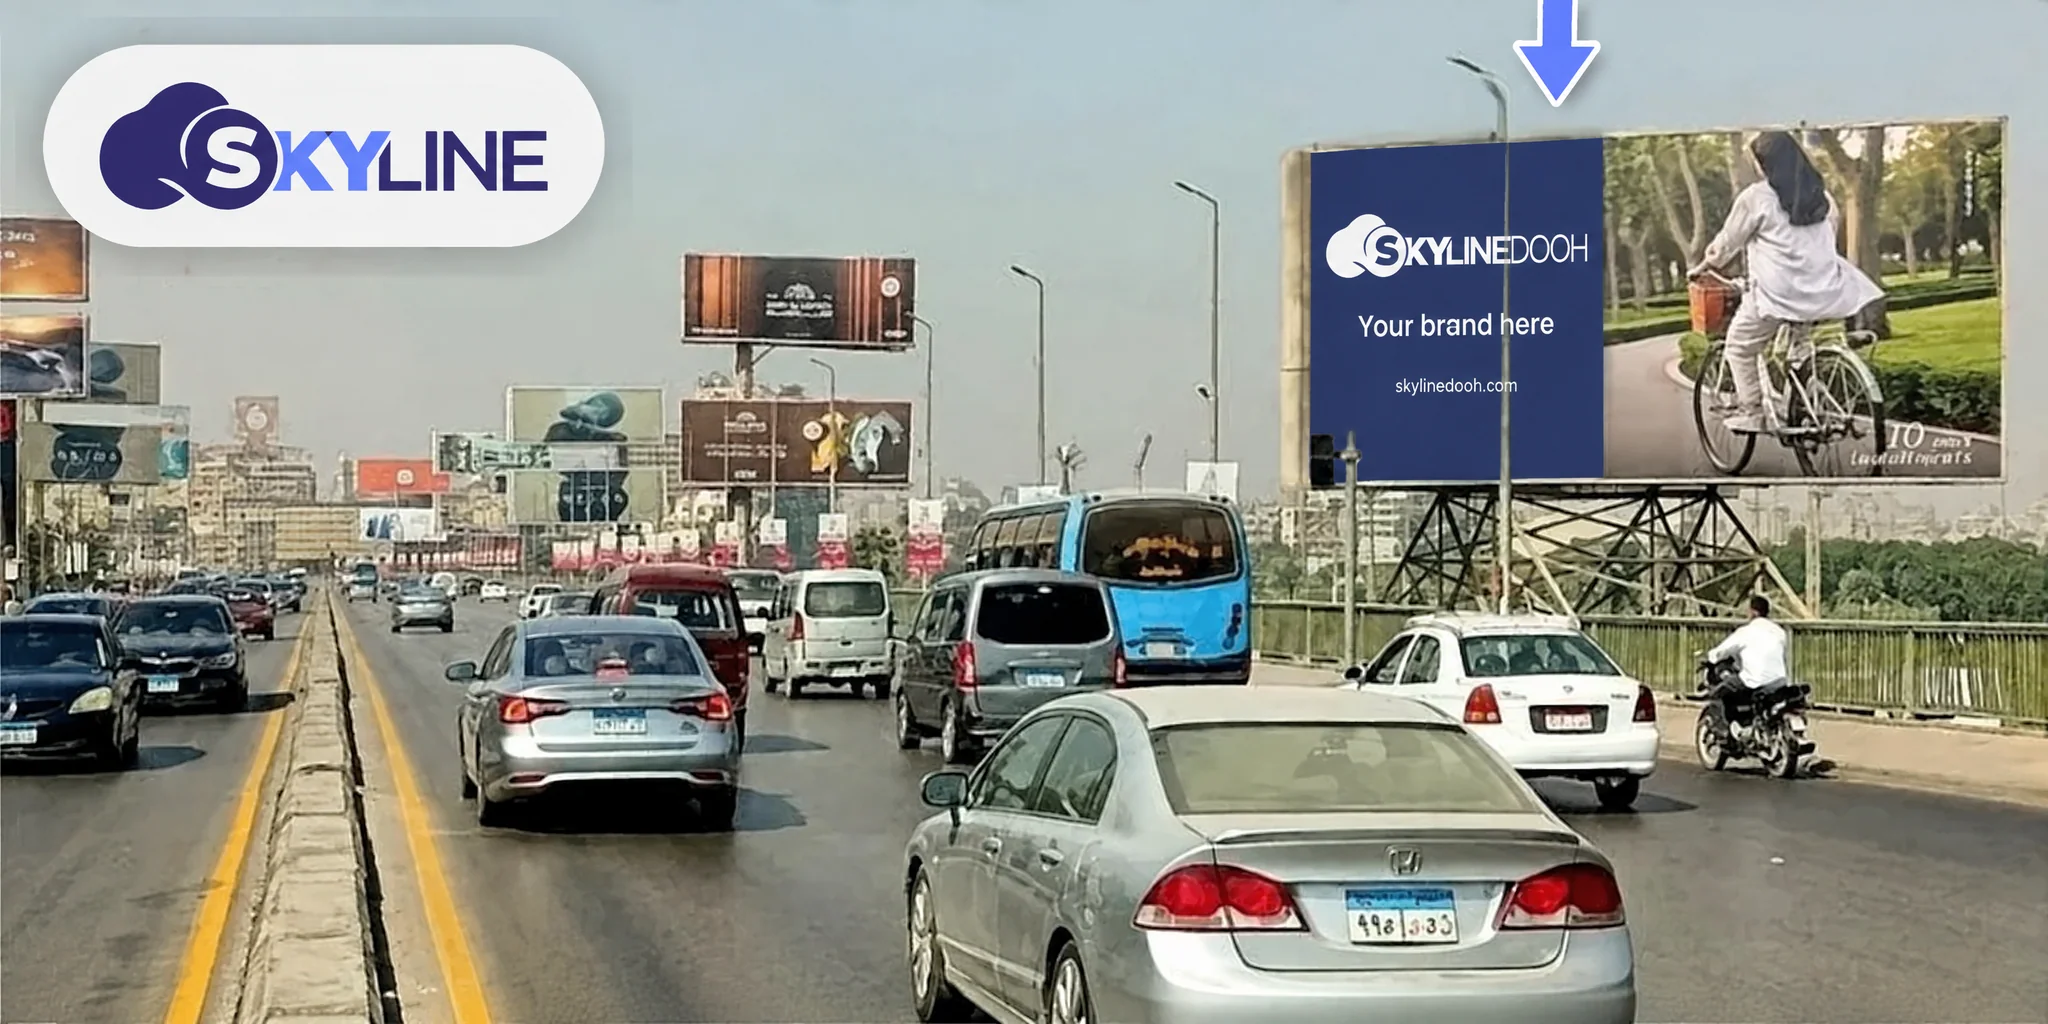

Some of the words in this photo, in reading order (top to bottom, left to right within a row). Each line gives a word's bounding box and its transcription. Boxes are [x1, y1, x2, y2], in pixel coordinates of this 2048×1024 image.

[1374, 233, 1588, 267] SKYLINEDOOH
[1358, 314, 1414, 338] Your
[1420, 313, 1492, 337] brand
[1500, 312, 1555, 336] here
[1394, 377, 1518, 397] skylinedooh.com
